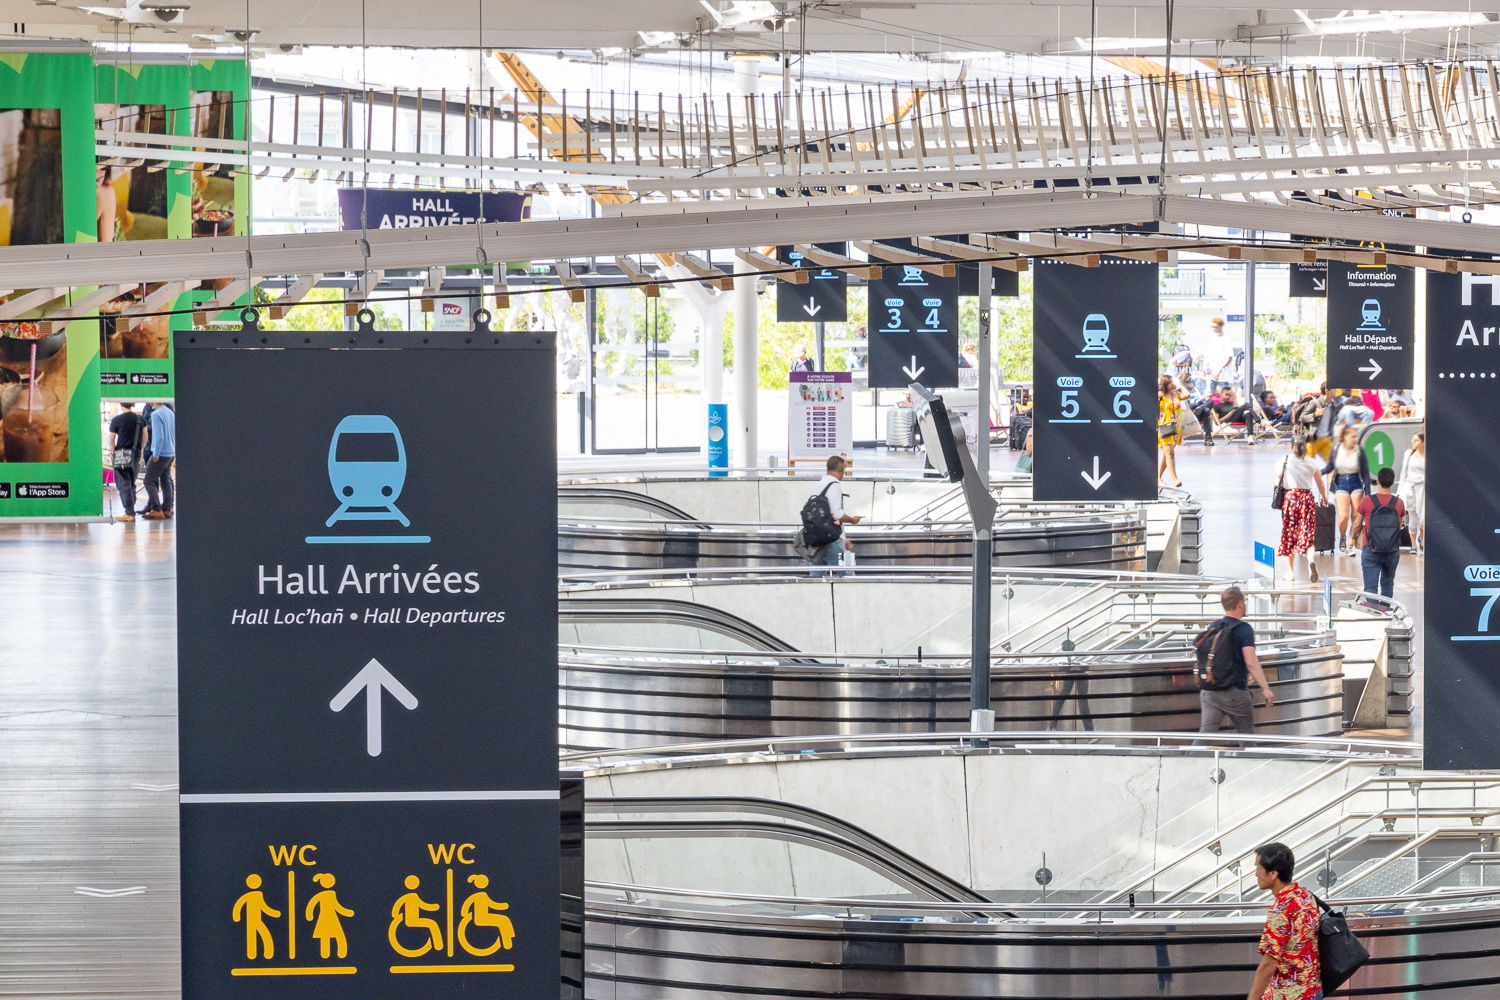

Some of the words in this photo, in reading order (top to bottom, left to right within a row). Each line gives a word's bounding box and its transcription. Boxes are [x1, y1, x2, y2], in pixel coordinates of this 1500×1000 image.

[412, 198, 454, 212] HALL
[1347, 271, 1397, 280] Information
[887, 308, 902, 329] 3
[925, 309, 940, 329] 4
[1345, 334, 1362, 343] Hall
[1364, 334, 1397, 344] Départs
[1060, 378, 1080, 386] Voie
[1112, 378, 1132, 386] Voie
[1061, 390, 1080, 418] 5
[1112, 390, 1132, 418] 6
[1372, 442, 1384, 465] 1
[29, 489, 46, 497] l'App
[258, 564, 329, 595] Hall
[338, 564, 480, 594] Arrivées
[1469, 567, 1500, 579] Voie
[231, 609, 269, 625] Hall
[363, 608, 401, 624] Hall
[405, 608, 505, 628] Departures
[1469, 587, 1500, 632] 7
[268, 844, 317, 866] WC
[427, 843, 476, 865] WC
